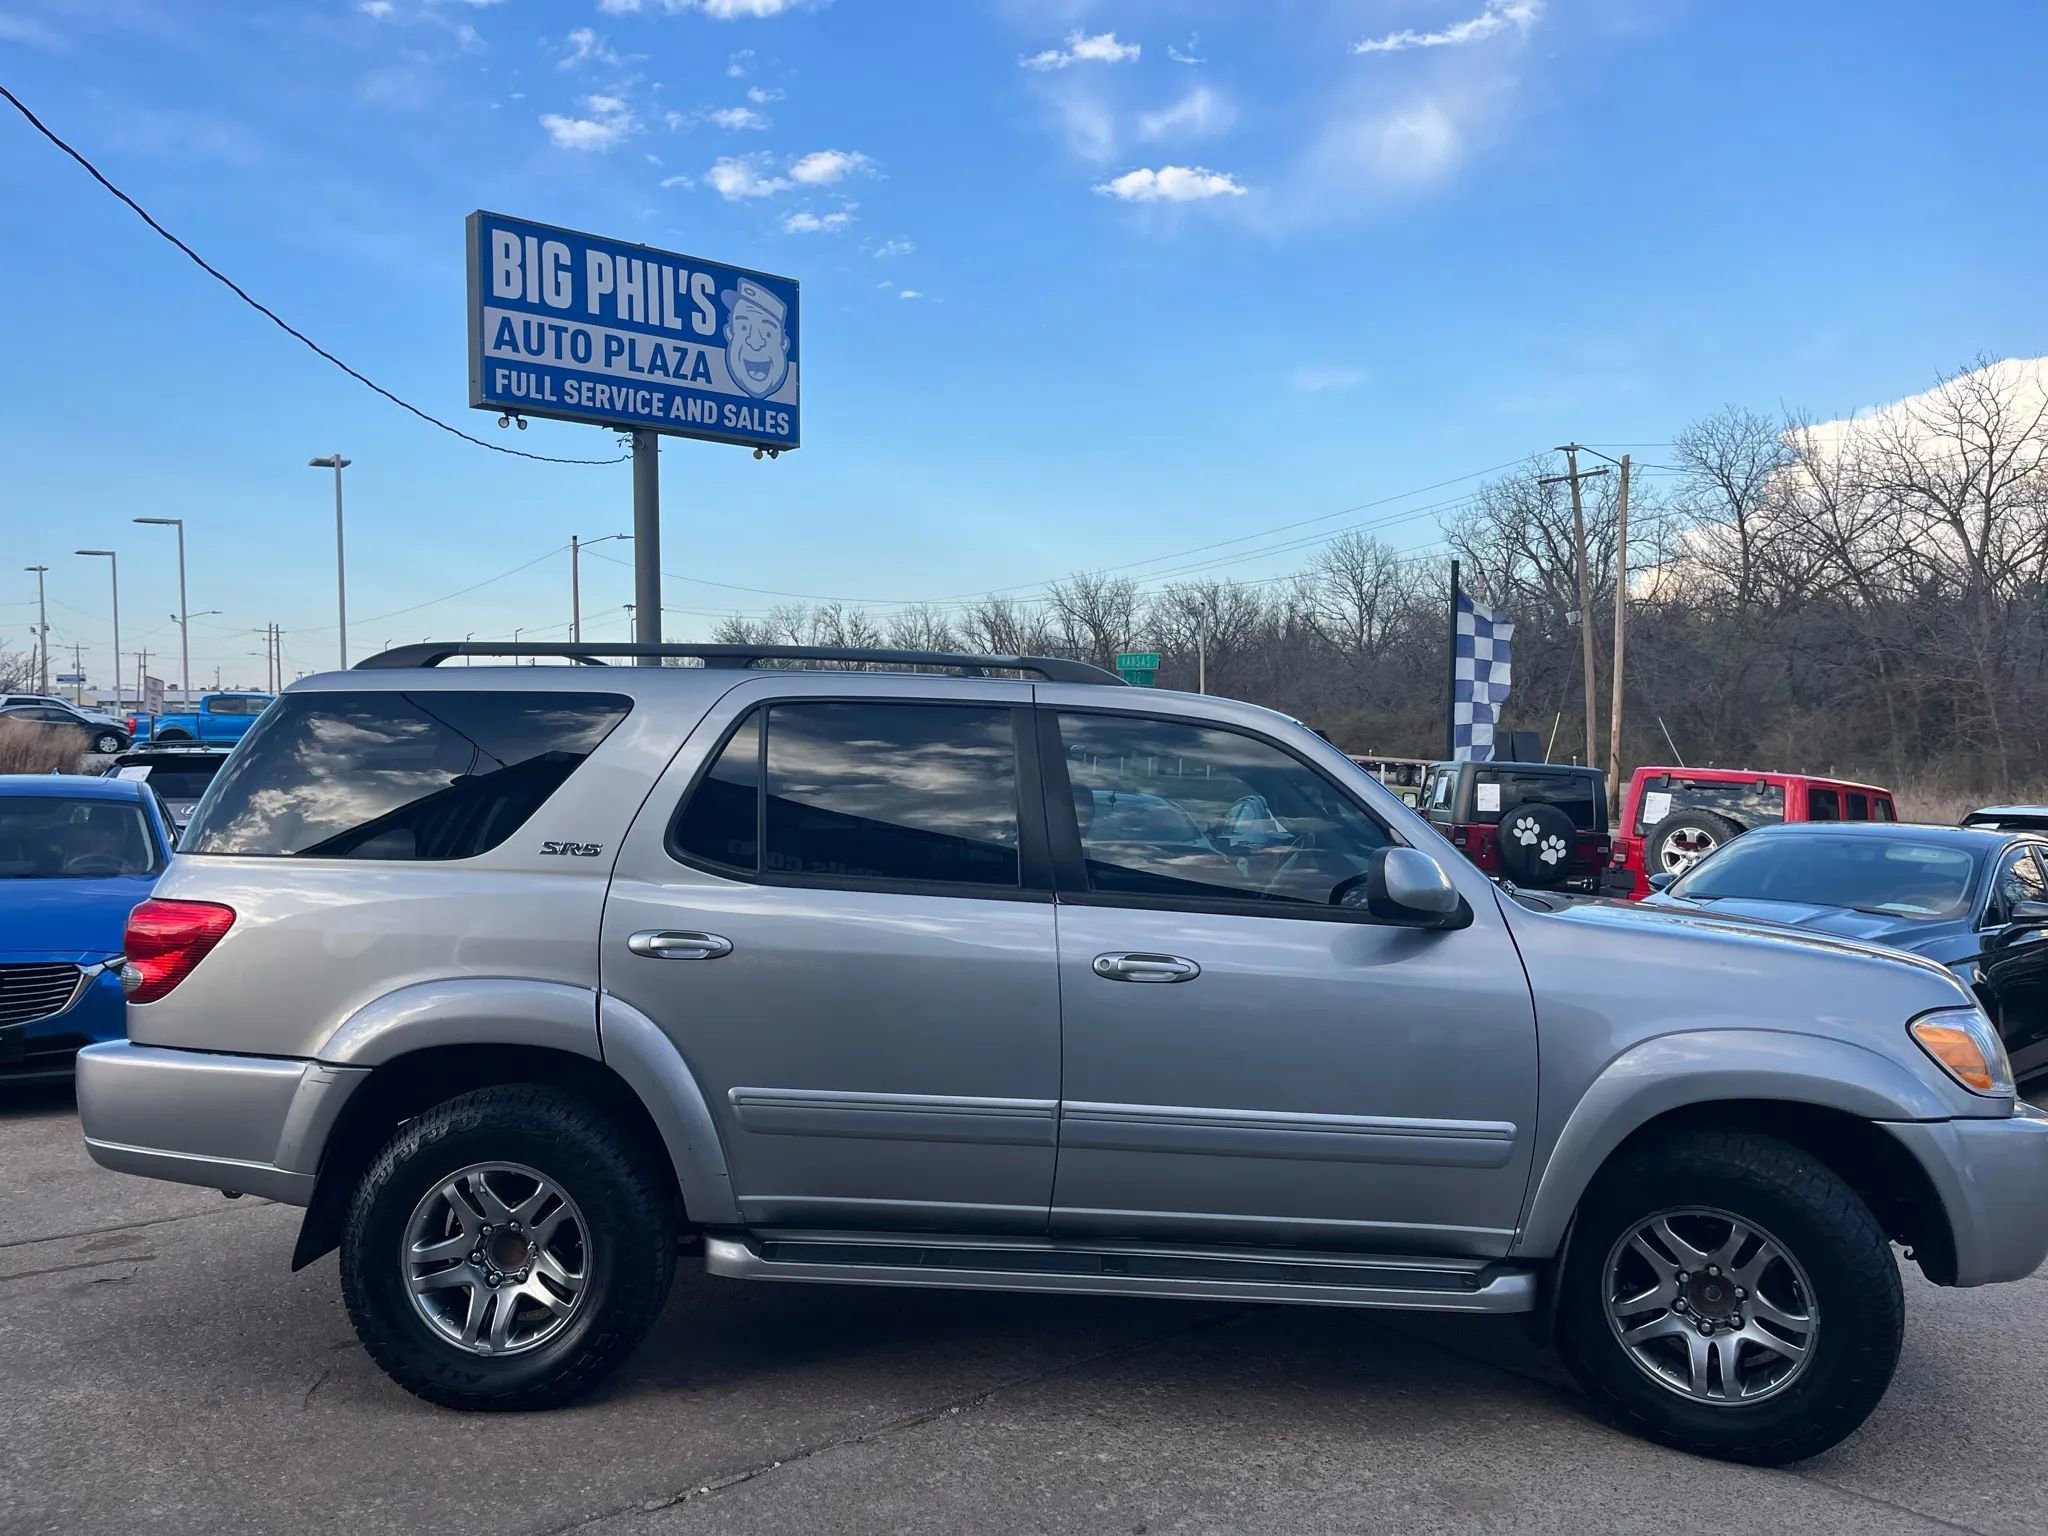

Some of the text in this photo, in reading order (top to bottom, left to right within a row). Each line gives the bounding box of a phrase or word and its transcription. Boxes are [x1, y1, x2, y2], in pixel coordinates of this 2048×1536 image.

[491, 228, 716, 336] BIG PHIL'S
[493, 316, 713, 385] AUTO PLAZA
[495, 368, 789, 436] FULL SERVICE AND SALES
[539, 841, 603, 857] SR5
